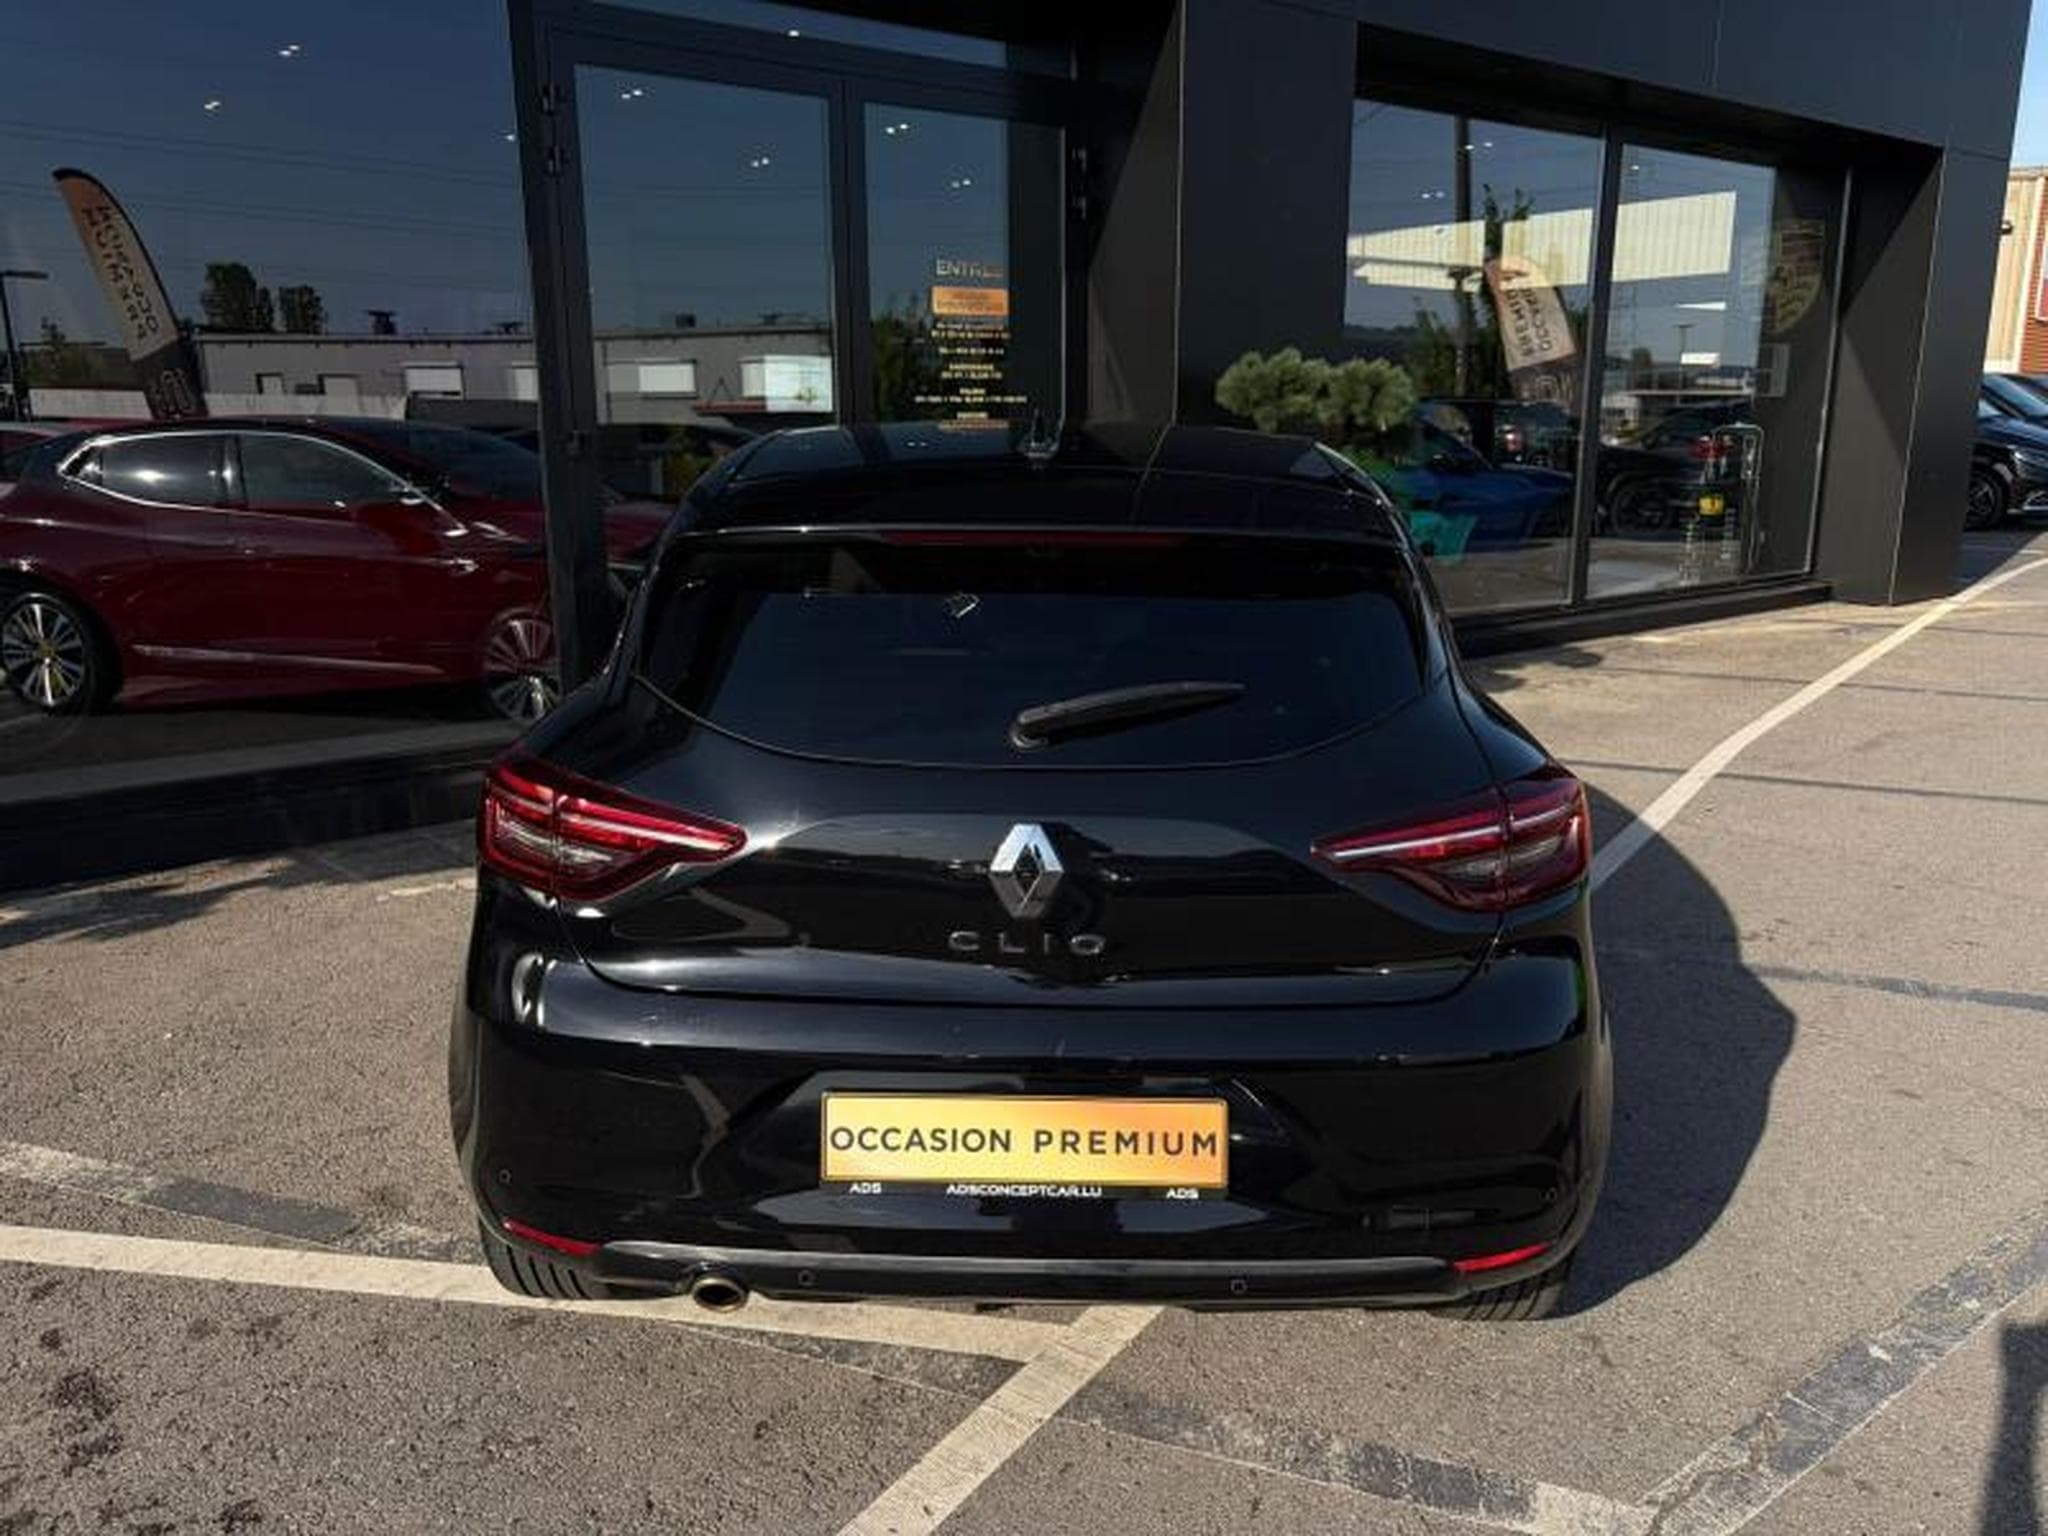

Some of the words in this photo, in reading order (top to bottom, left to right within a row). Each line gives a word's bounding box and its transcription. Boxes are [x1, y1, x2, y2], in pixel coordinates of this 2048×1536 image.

[949, 930, 1107, 955] CLIO
[830, 1126, 1011, 1153] OCCASION
[1034, 1129, 1217, 1157] PREMIUM
[849, 1182, 883, 1195] ADS
[946, 1183, 1103, 1199] ADSCONCEPTCAR.LU
[1166, 1187, 1199, 1201] ADS
